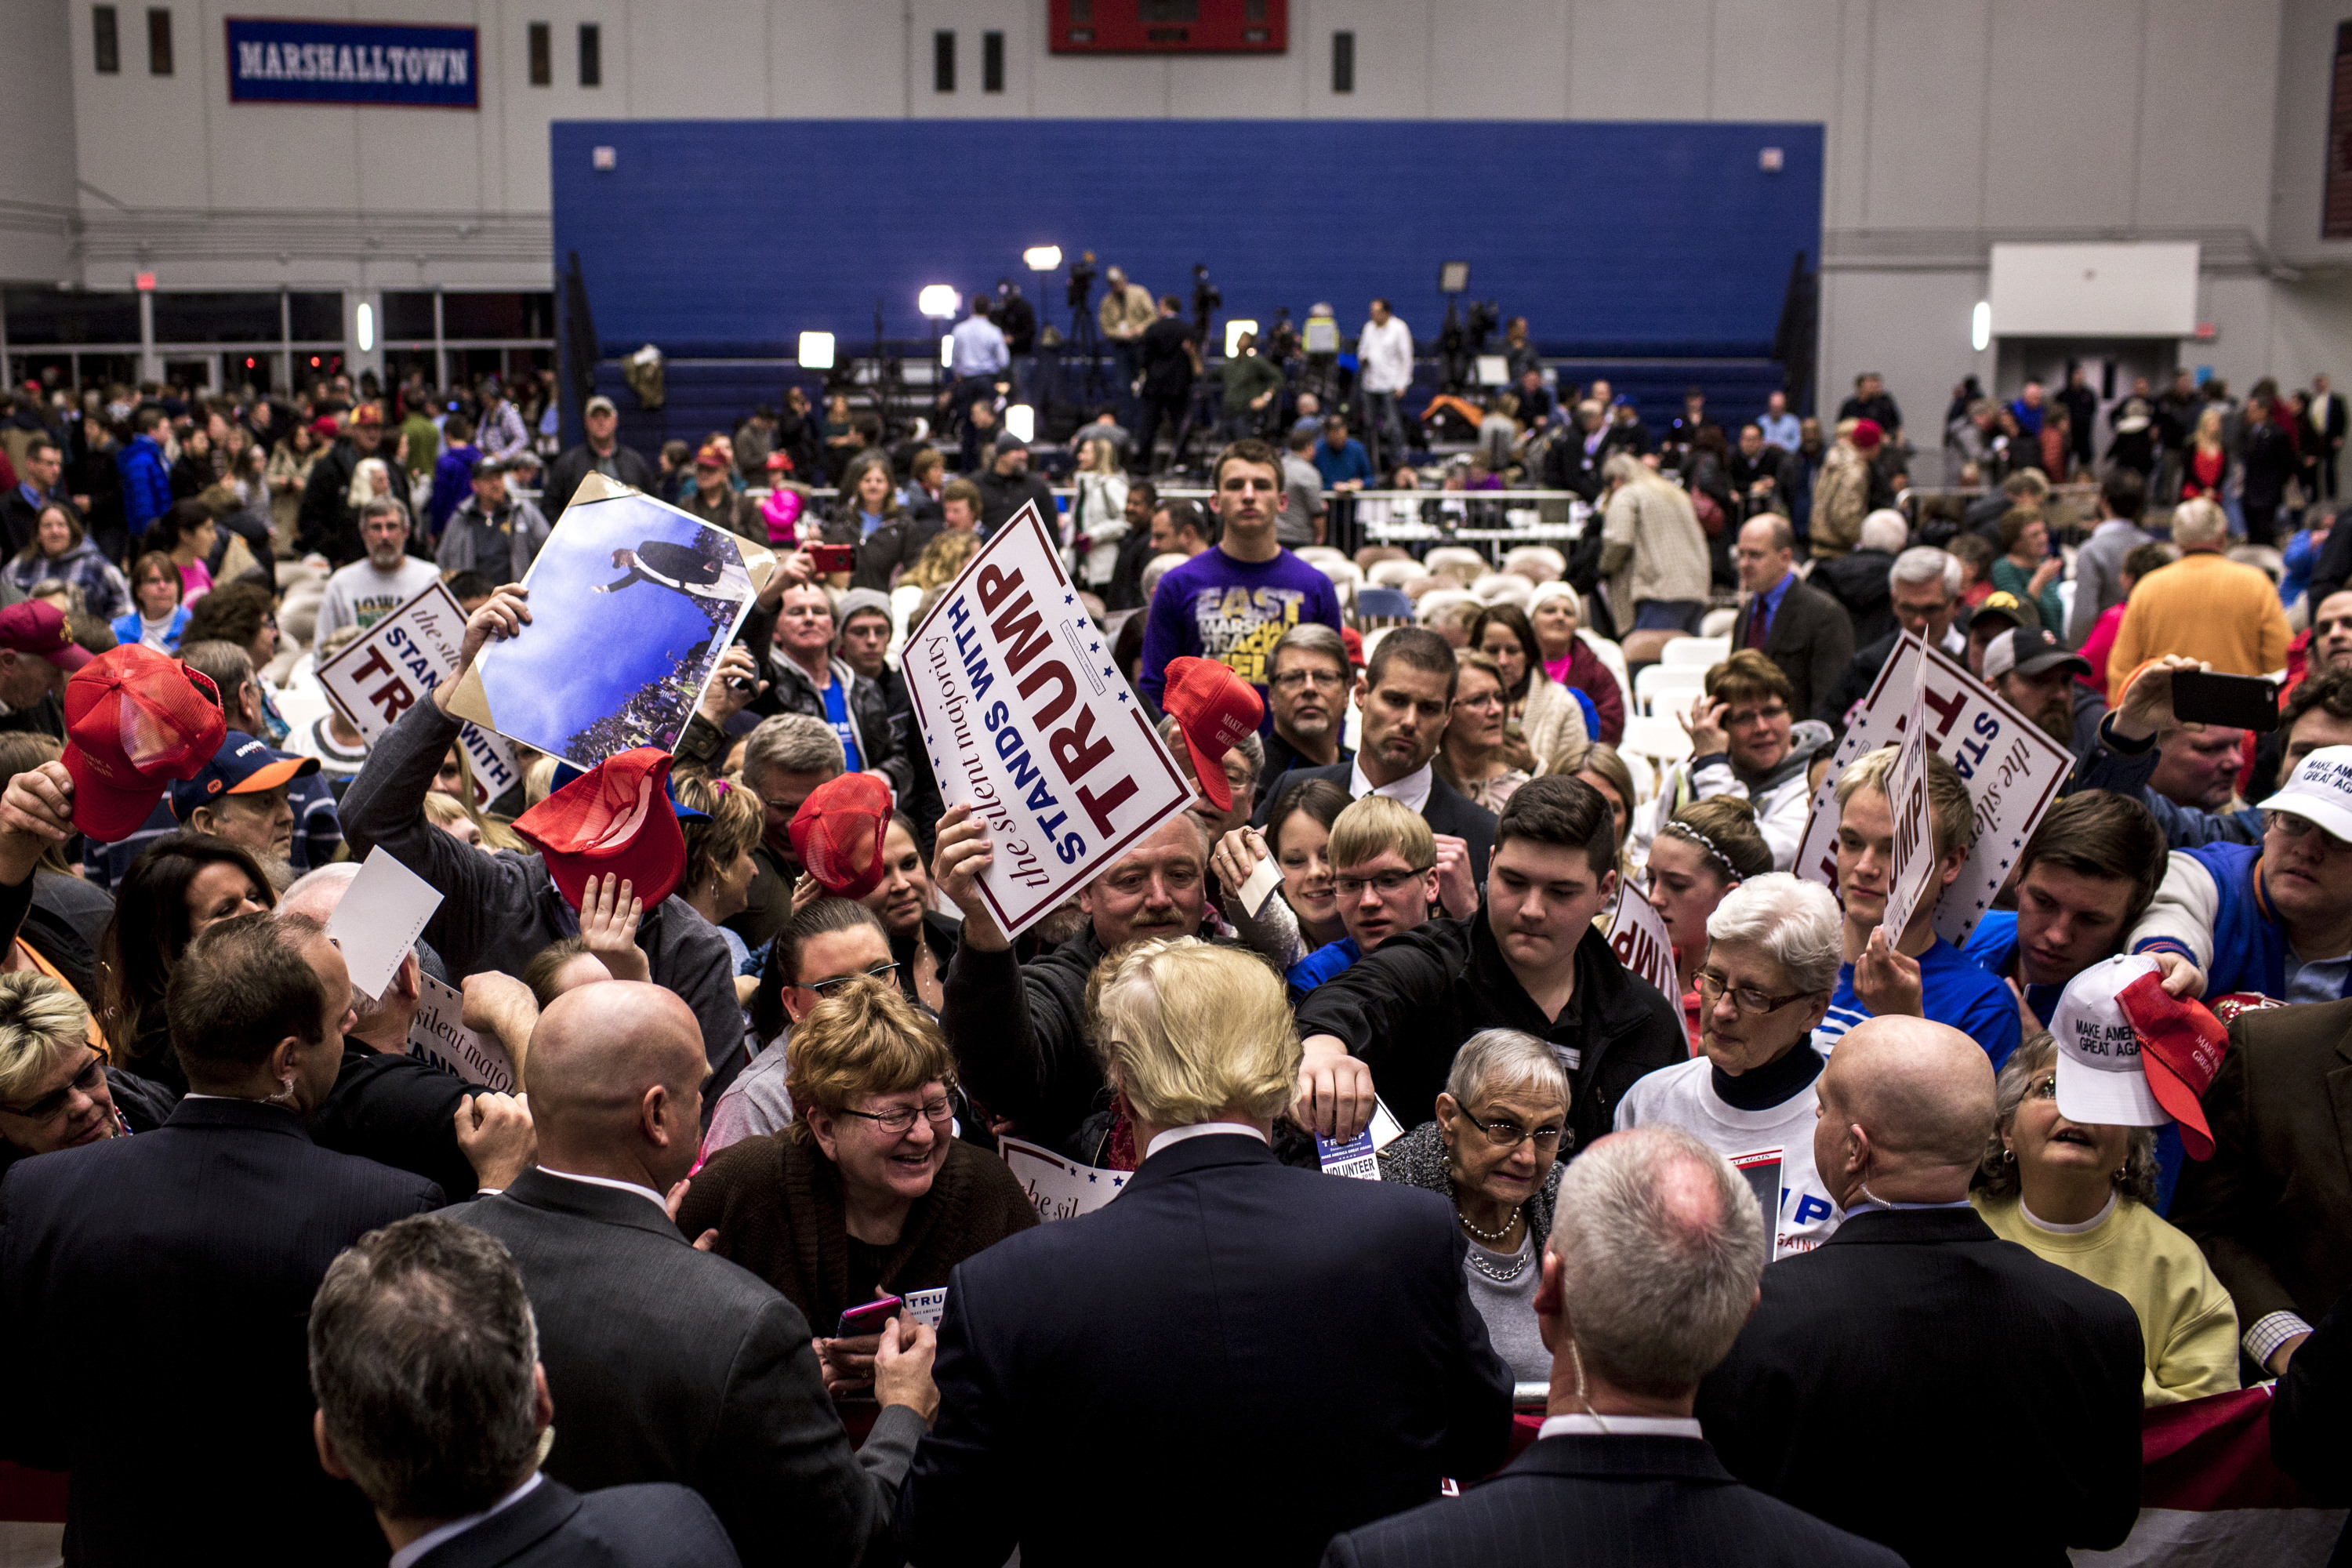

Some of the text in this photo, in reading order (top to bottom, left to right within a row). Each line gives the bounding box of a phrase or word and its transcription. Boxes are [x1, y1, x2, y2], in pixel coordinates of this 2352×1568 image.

[238, 41, 468, 85] MARSHALLTOWN
[1196, 586, 1305, 626] EAST
[411, 609, 442, 640] the
[1083, 662, 1093, 674] Donald
[977, 563, 1140, 840] TRUMP
[947, 595, 1087, 865] STANDS WITH
[1221, 713, 1243, 734] MAKE
[460, 721, 511, 786] WITH
[926, 636, 1051, 888] the silent majority
[1998, 737, 2031, 786] the
[2307, 760, 2333, 771] MAKE
[2303, 771, 2333, 784] GREAT
[416, 1006, 466, 1054] silent
[2076, 1019, 2100, 1041] MAKE
[2080, 1036, 2110, 1056] GREAT
[2196, 1034, 2216, 1056] MAKE
[2192, 1050, 2212, 1076] GREAT
[1322, 1131, 1365, 1148] TRMP
[1326, 1157, 1375, 1177] VOLUNTEER
[1744, 1154, 1770, 1163] AGAIN
[1021, 1178, 1051, 1216] he
[909, 1294, 943, 1308] TRU
